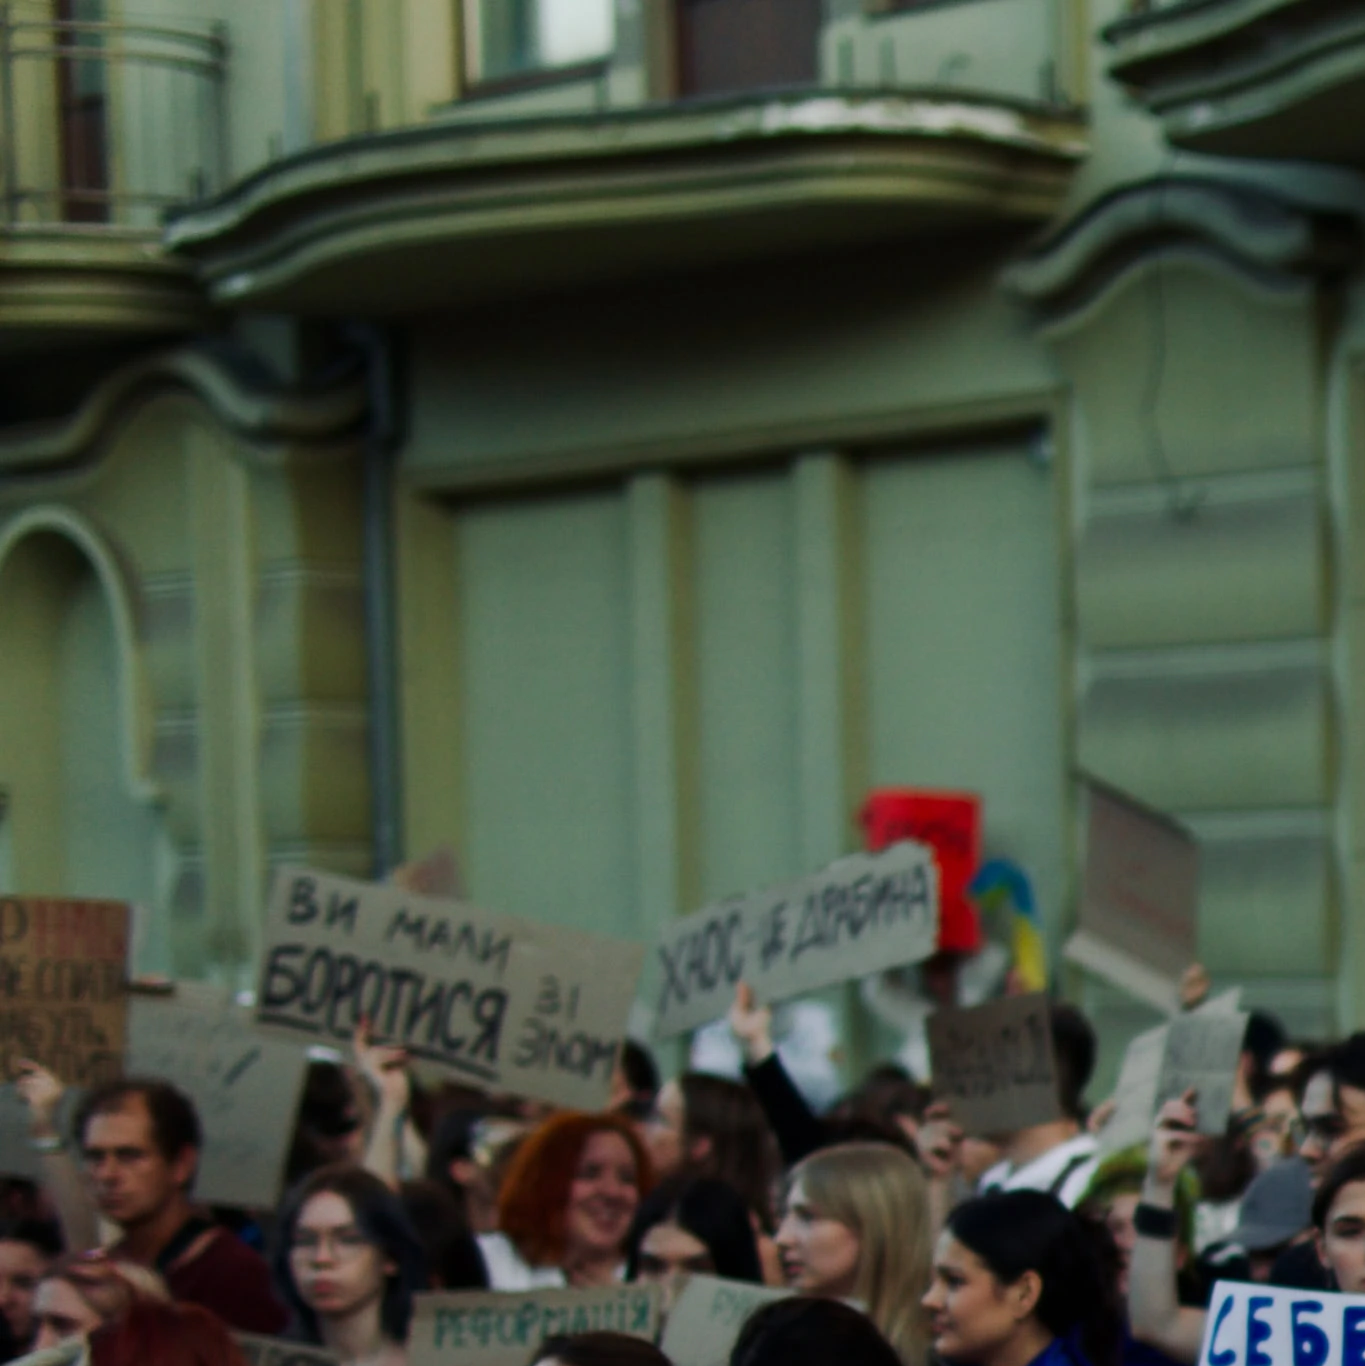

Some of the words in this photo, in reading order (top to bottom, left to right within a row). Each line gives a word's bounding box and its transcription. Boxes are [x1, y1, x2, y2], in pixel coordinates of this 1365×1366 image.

[286, 874, 359, 934] ВИ
[384, 906, 514, 973] МАЛИ
[263, 943, 510, 1060] БОРОТИСЯ
